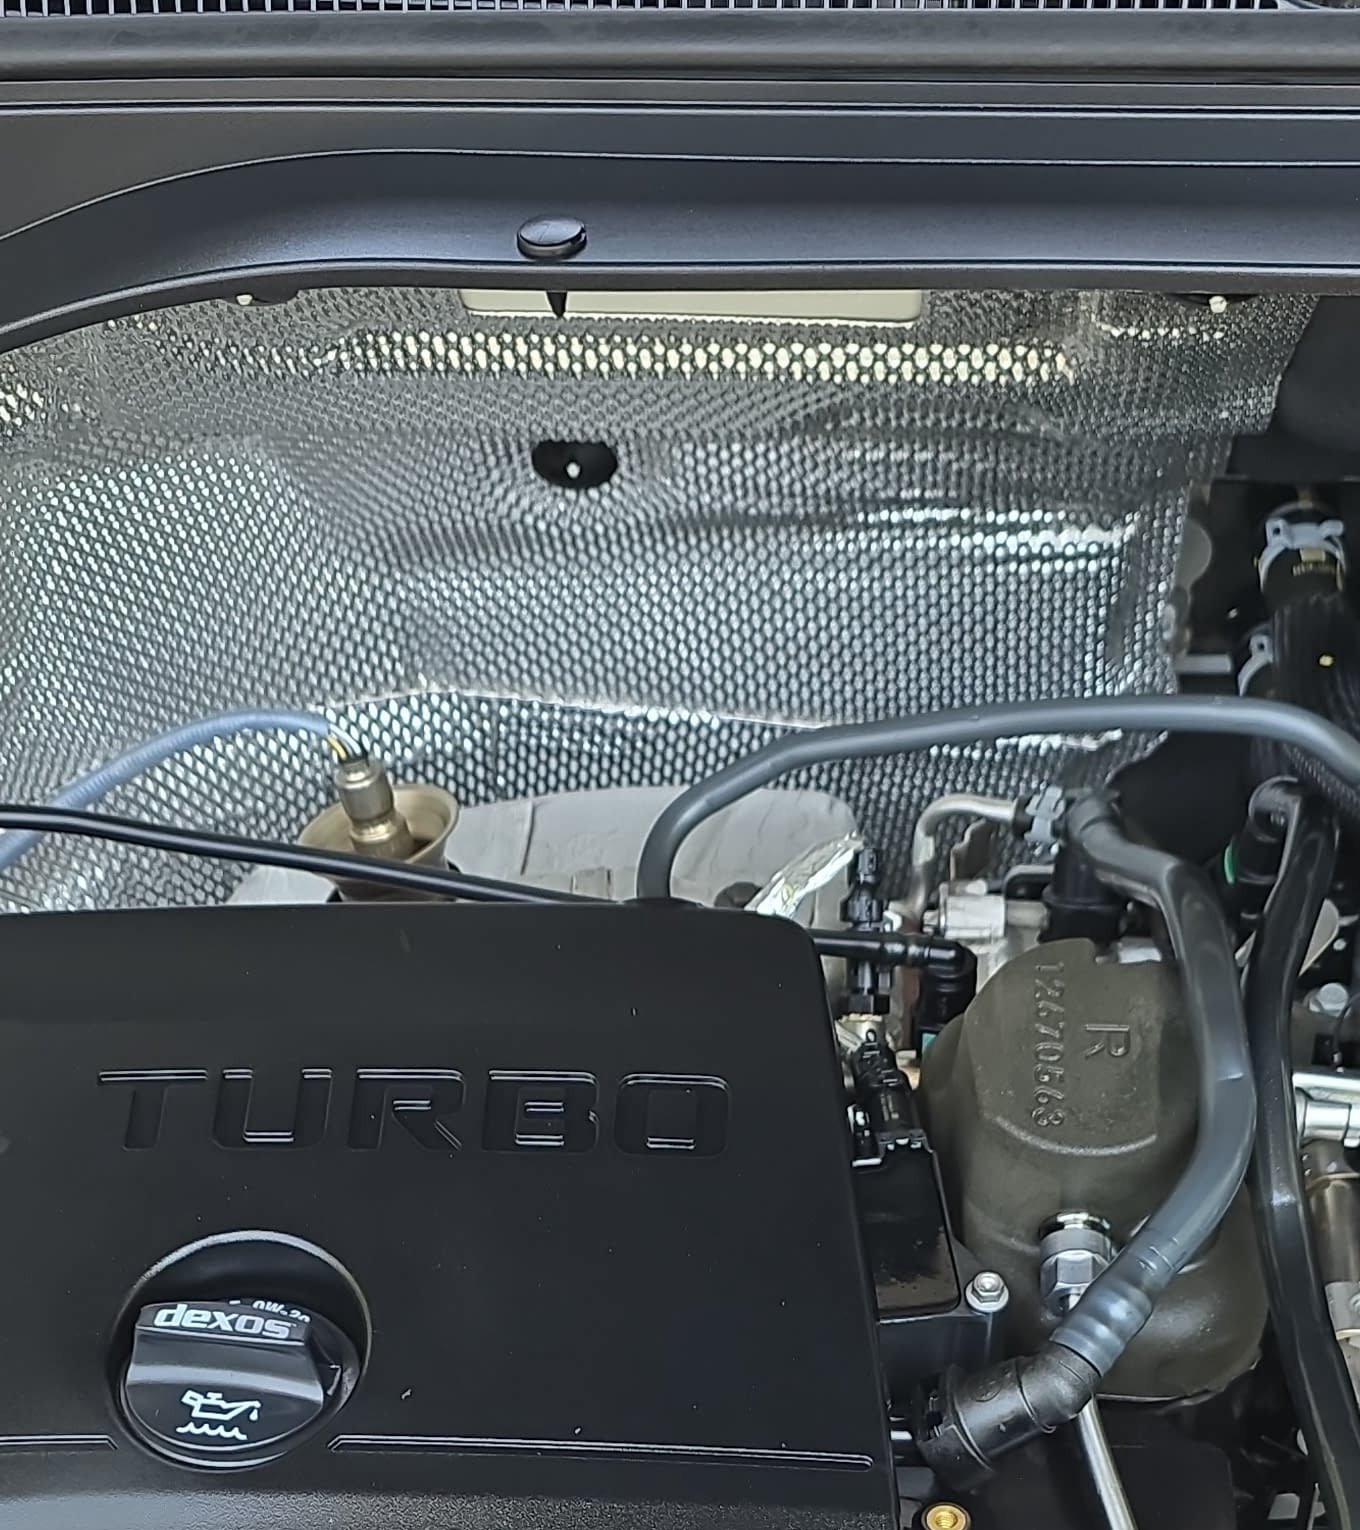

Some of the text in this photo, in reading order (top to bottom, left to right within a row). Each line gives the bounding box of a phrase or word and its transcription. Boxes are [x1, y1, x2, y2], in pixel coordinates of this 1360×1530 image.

[1031, 962, 1066, 1129] 12670563
[1085, 1023, 1130, 1058] R
[96, 1066, 732, 1158] TURBO
[153, 1303, 292, 1339] dexos
